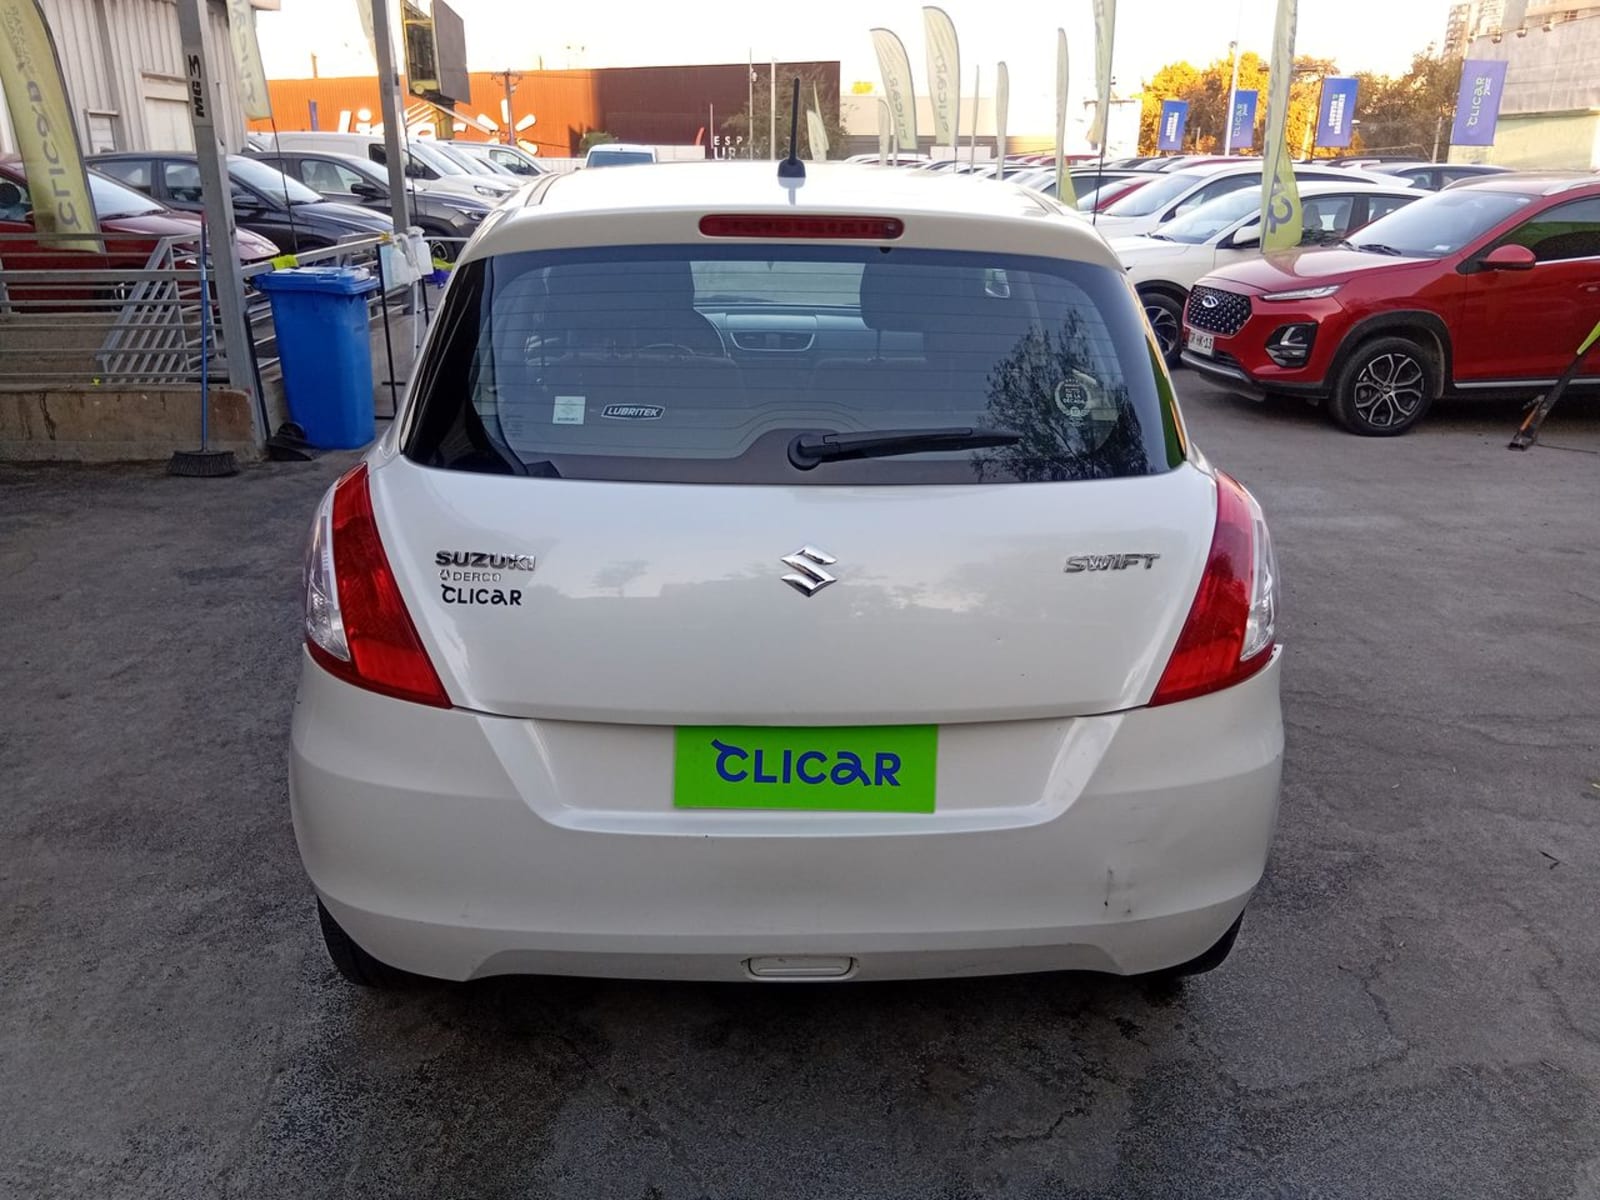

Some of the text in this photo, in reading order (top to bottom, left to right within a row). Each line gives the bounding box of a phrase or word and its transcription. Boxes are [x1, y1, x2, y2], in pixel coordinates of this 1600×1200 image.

[607, 407, 660, 417] LUBRITEK
[435, 550, 536, 571] SUZUKI
[1064, 553, 1161, 573] SWIFT
[453, 571, 502, 582] DERCO
